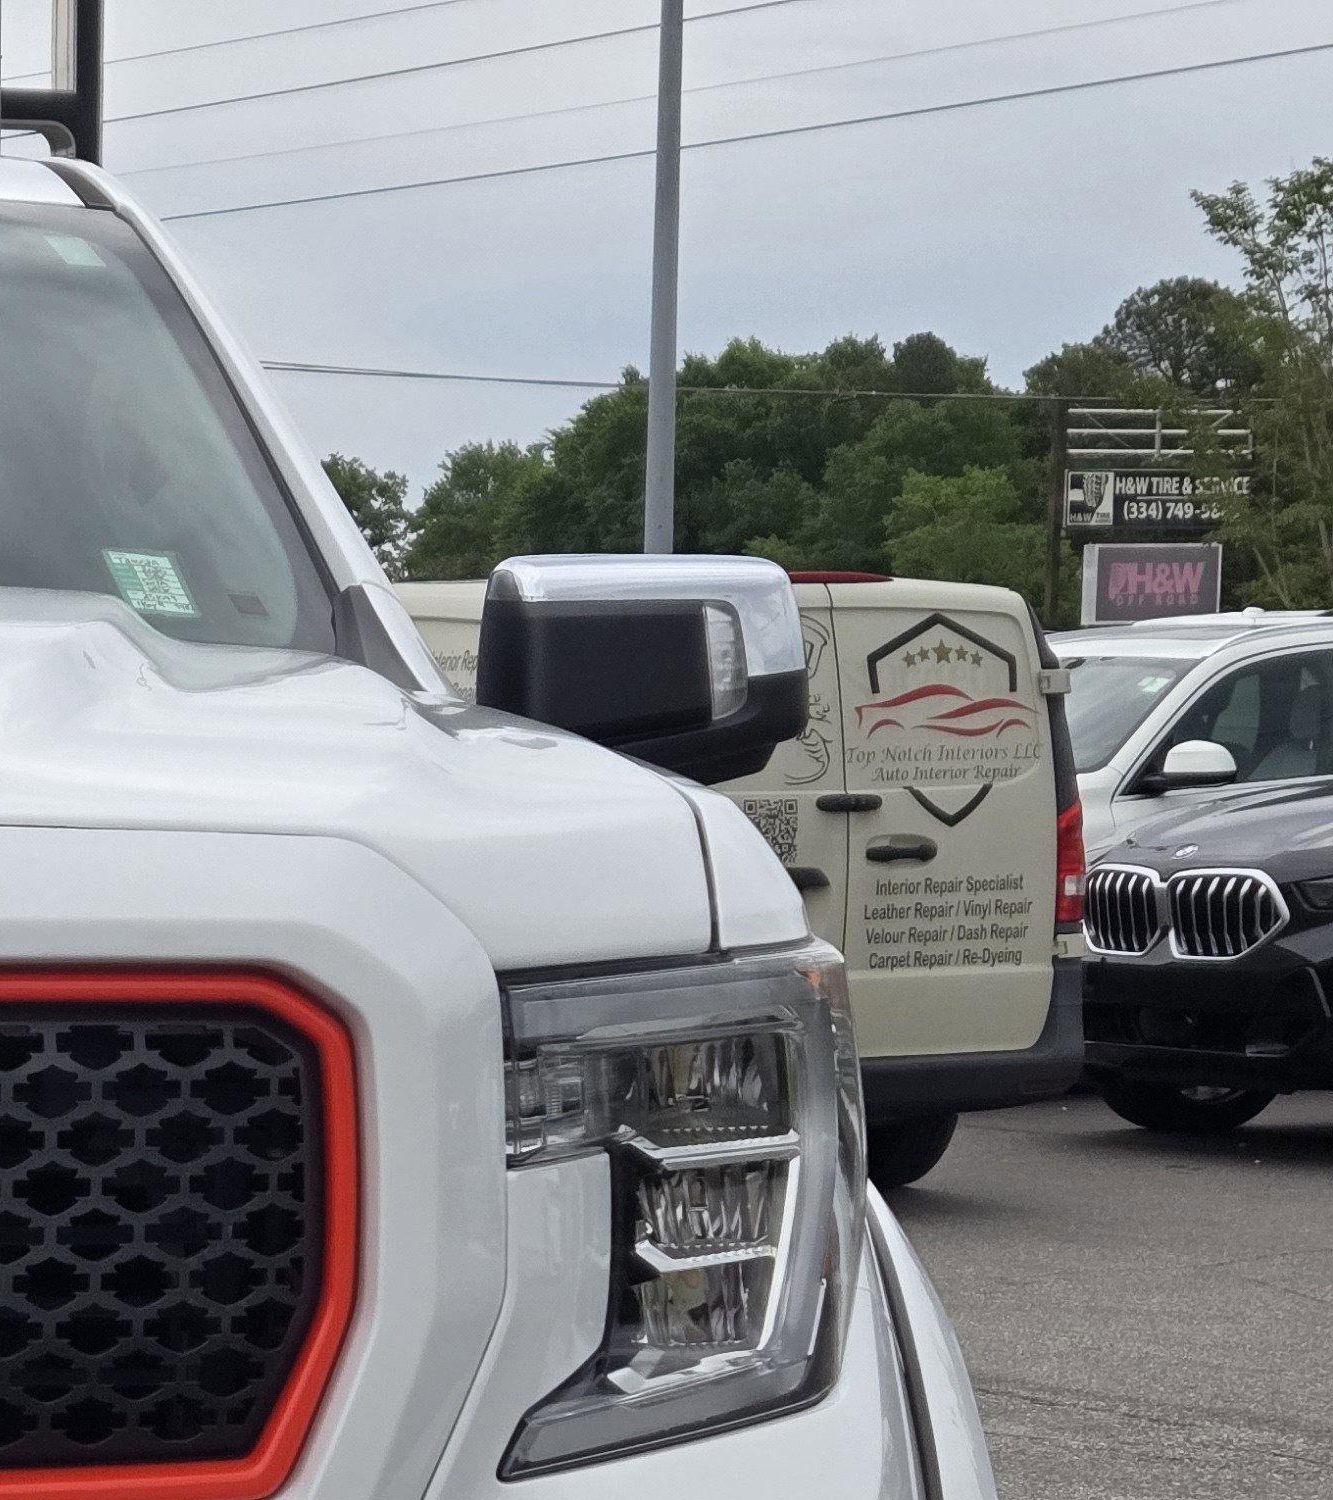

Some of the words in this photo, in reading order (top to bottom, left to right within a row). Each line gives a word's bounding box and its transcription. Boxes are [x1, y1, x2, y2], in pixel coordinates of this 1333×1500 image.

[1115, 476, 1149, 494] H&W
[1151, 476, 1180, 494] TIRE
[1182, 476, 1192, 494] &
[1123, 501, 1162, 520] (334)
[1127, 562, 1205, 594] H&W
[845, 747, 876, 768] Top
[881, 746, 931, 763] Notch
[937, 744, 1008, 761] Interiors
[1013, 743, 1044, 760] LLC
[871, 767, 909, 781] Auto
[912, 766, 969, 780] Interior
[974, 764, 1021, 781] Repair
[876, 879, 921, 896] Interior
[924, 876, 963, 897] Repair
[966, 873, 1024, 896] Specialist
[864, 903, 911, 920] Leather
[914, 901, 954, 921] Repair
[963, 899, 991, 920] Vinyl
[994, 898, 1033, 918] Repair
[866, 927, 906, 945] Velour
[908, 925, 948, 946] Repair
[957, 924, 986, 941] Dash
[990, 922, 1029, 942] Repair
[869, 951, 911, 971] Carpet
[914, 950, 953, 969] Repair
[962, 947, 1023, 967] Re-Dyeing
